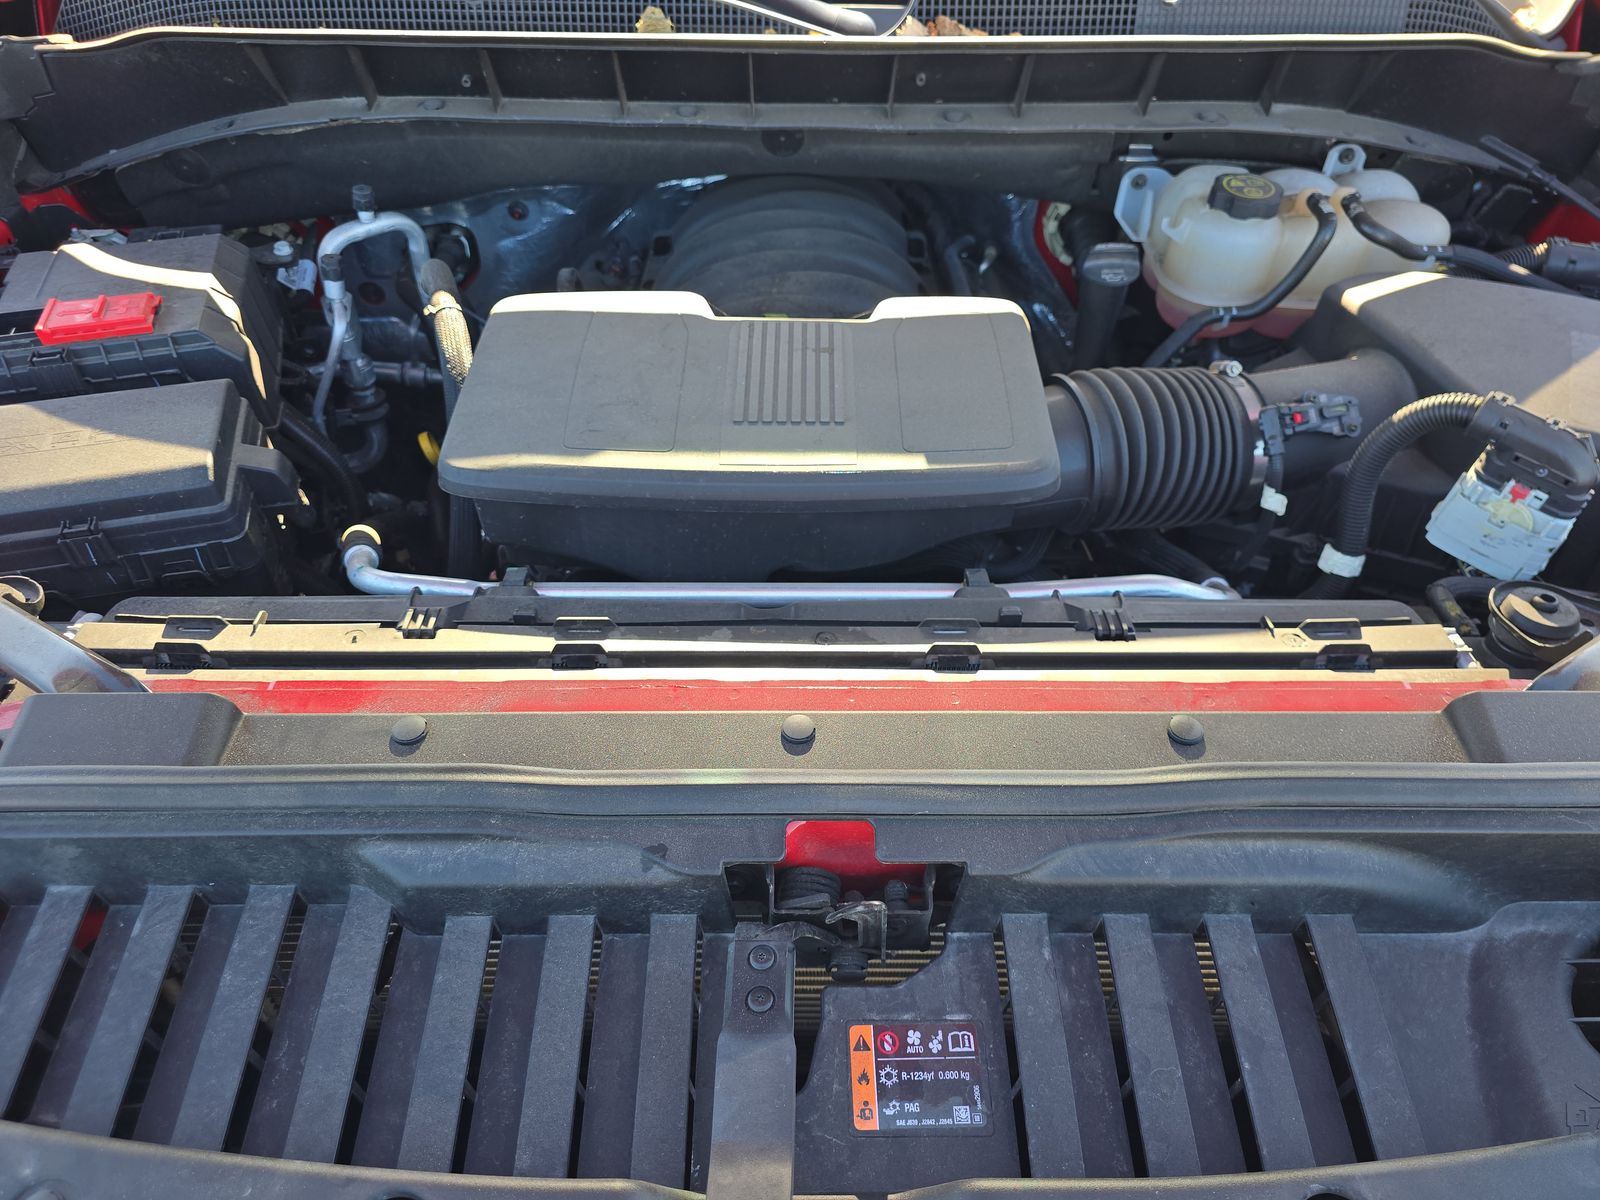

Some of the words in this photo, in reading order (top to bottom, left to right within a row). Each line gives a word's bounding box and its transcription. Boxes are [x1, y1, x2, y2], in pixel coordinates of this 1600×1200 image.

[906, 1045, 924, 1054] AUTO
[938, 1070, 959, 1080] 0.600
[960, 1070, 970, 1080] kg
[904, 1102, 920, 1112] PAG
